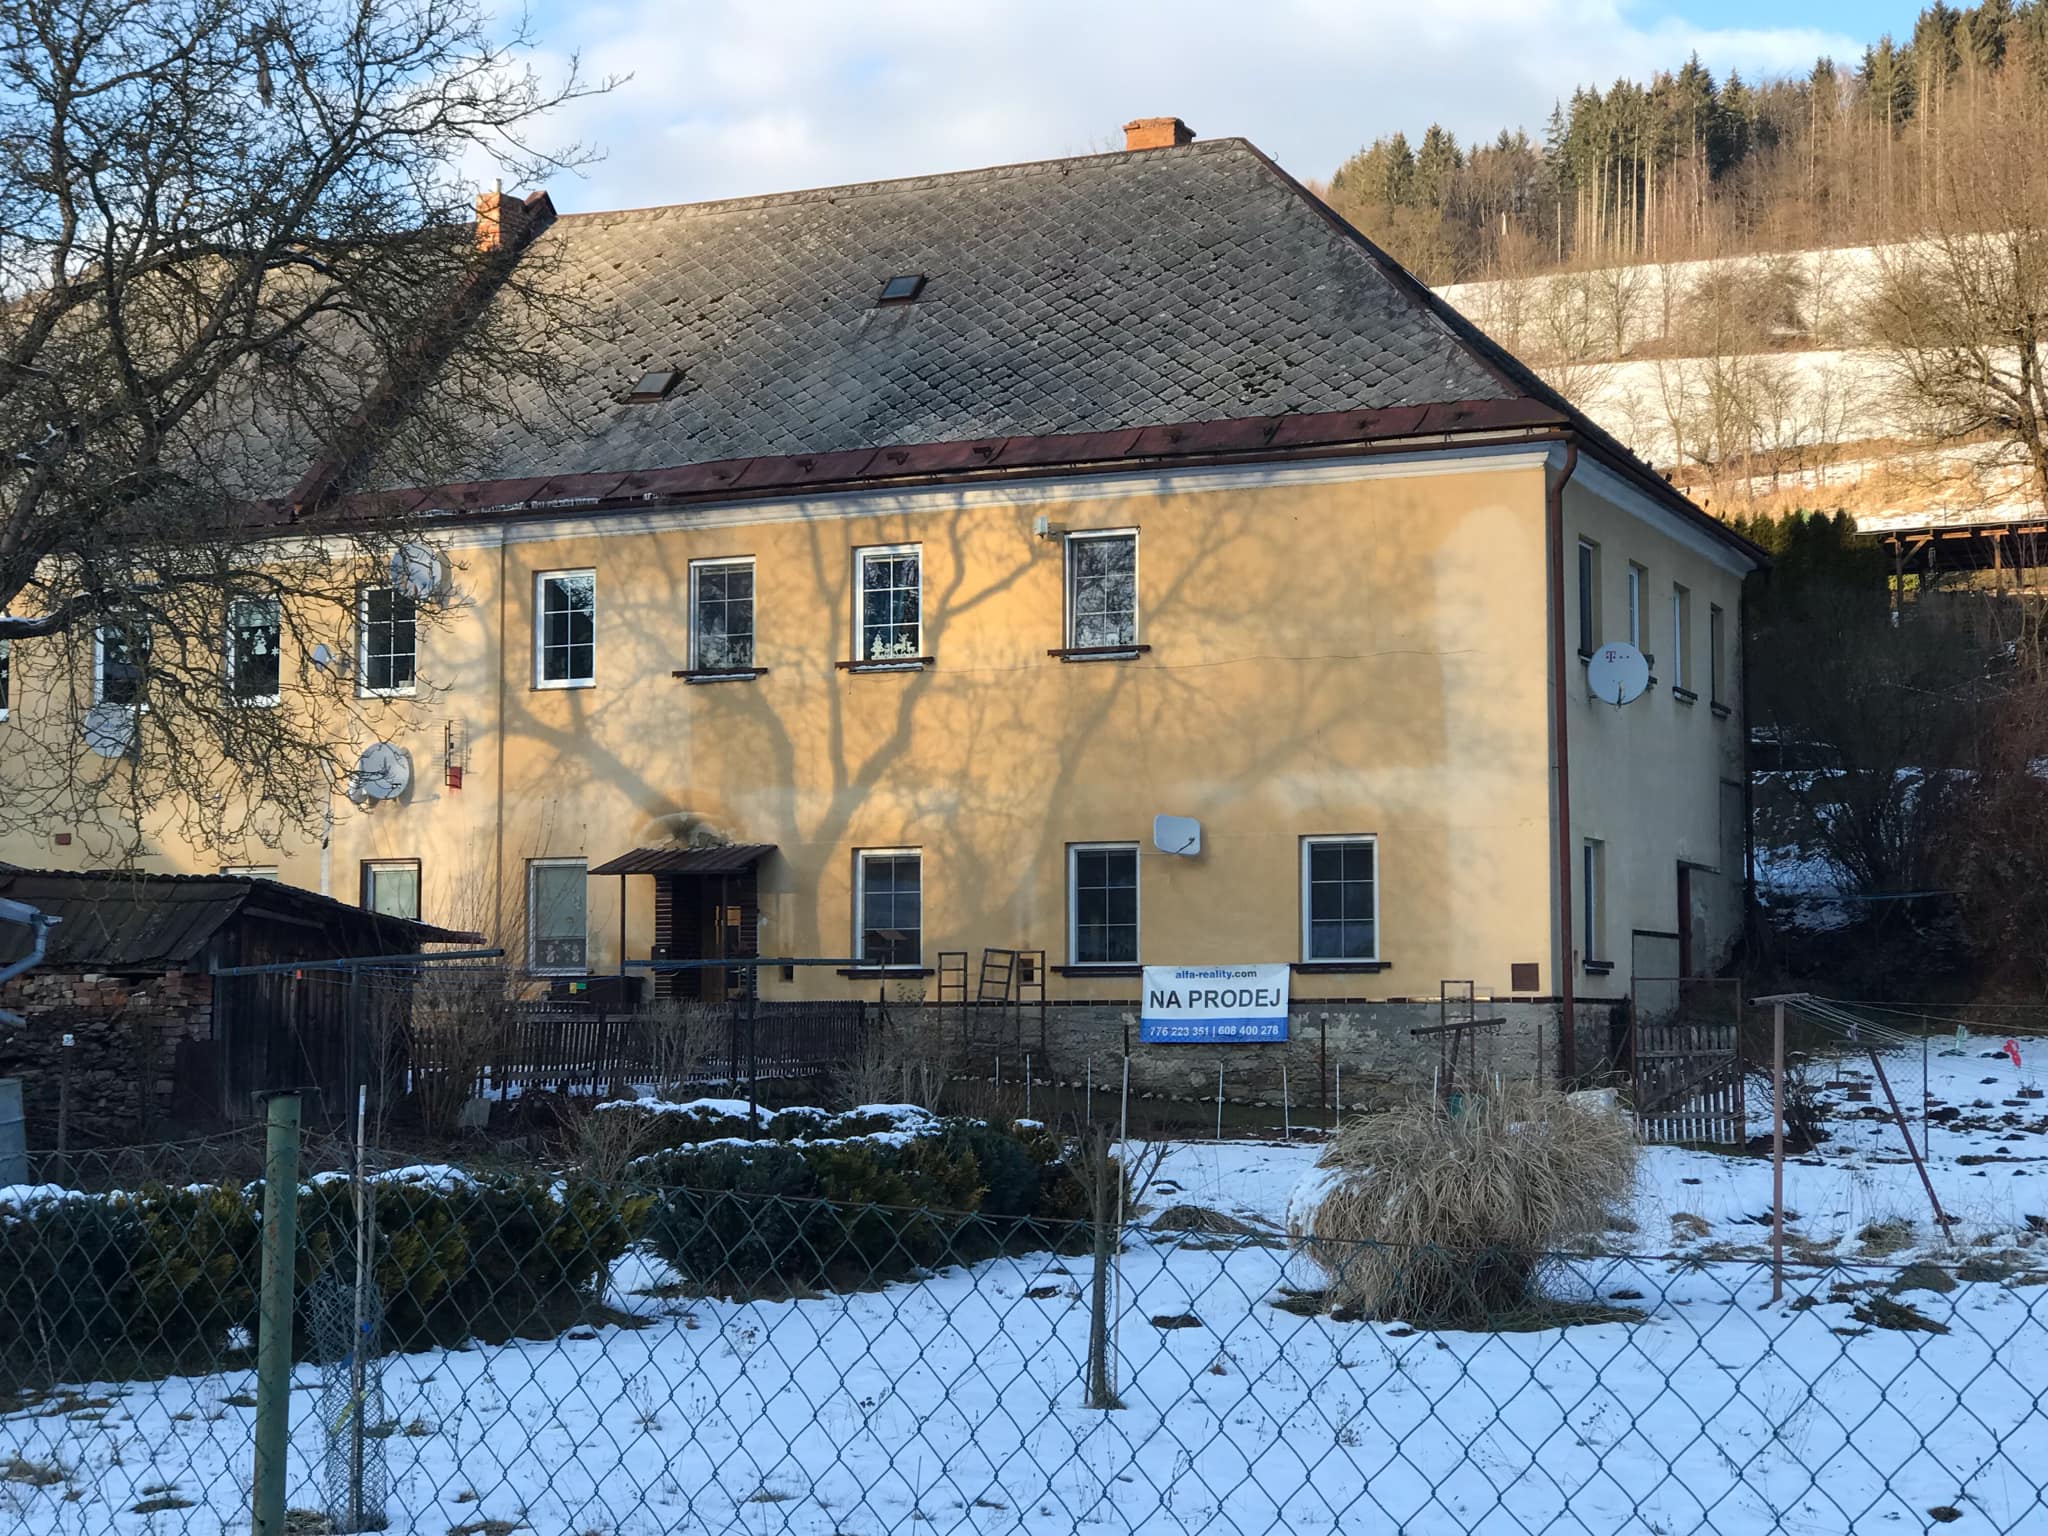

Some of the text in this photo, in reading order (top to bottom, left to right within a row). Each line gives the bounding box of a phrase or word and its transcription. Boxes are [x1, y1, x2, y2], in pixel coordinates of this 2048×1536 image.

[1175, 969, 1257, 980] alfa-reality.com
[1150, 988, 1280, 1008] NA PRODEJ
[1150, 1026, 1169, 1036] 776
[1171, 1026, 1189, 1036] 223
[1192, 1026, 1209, 1036] 351
[1218, 1025, 1236, 1035] 608
[1239, 1025, 1258, 1035] 400
[1261, 1025, 1279, 1035] 278
